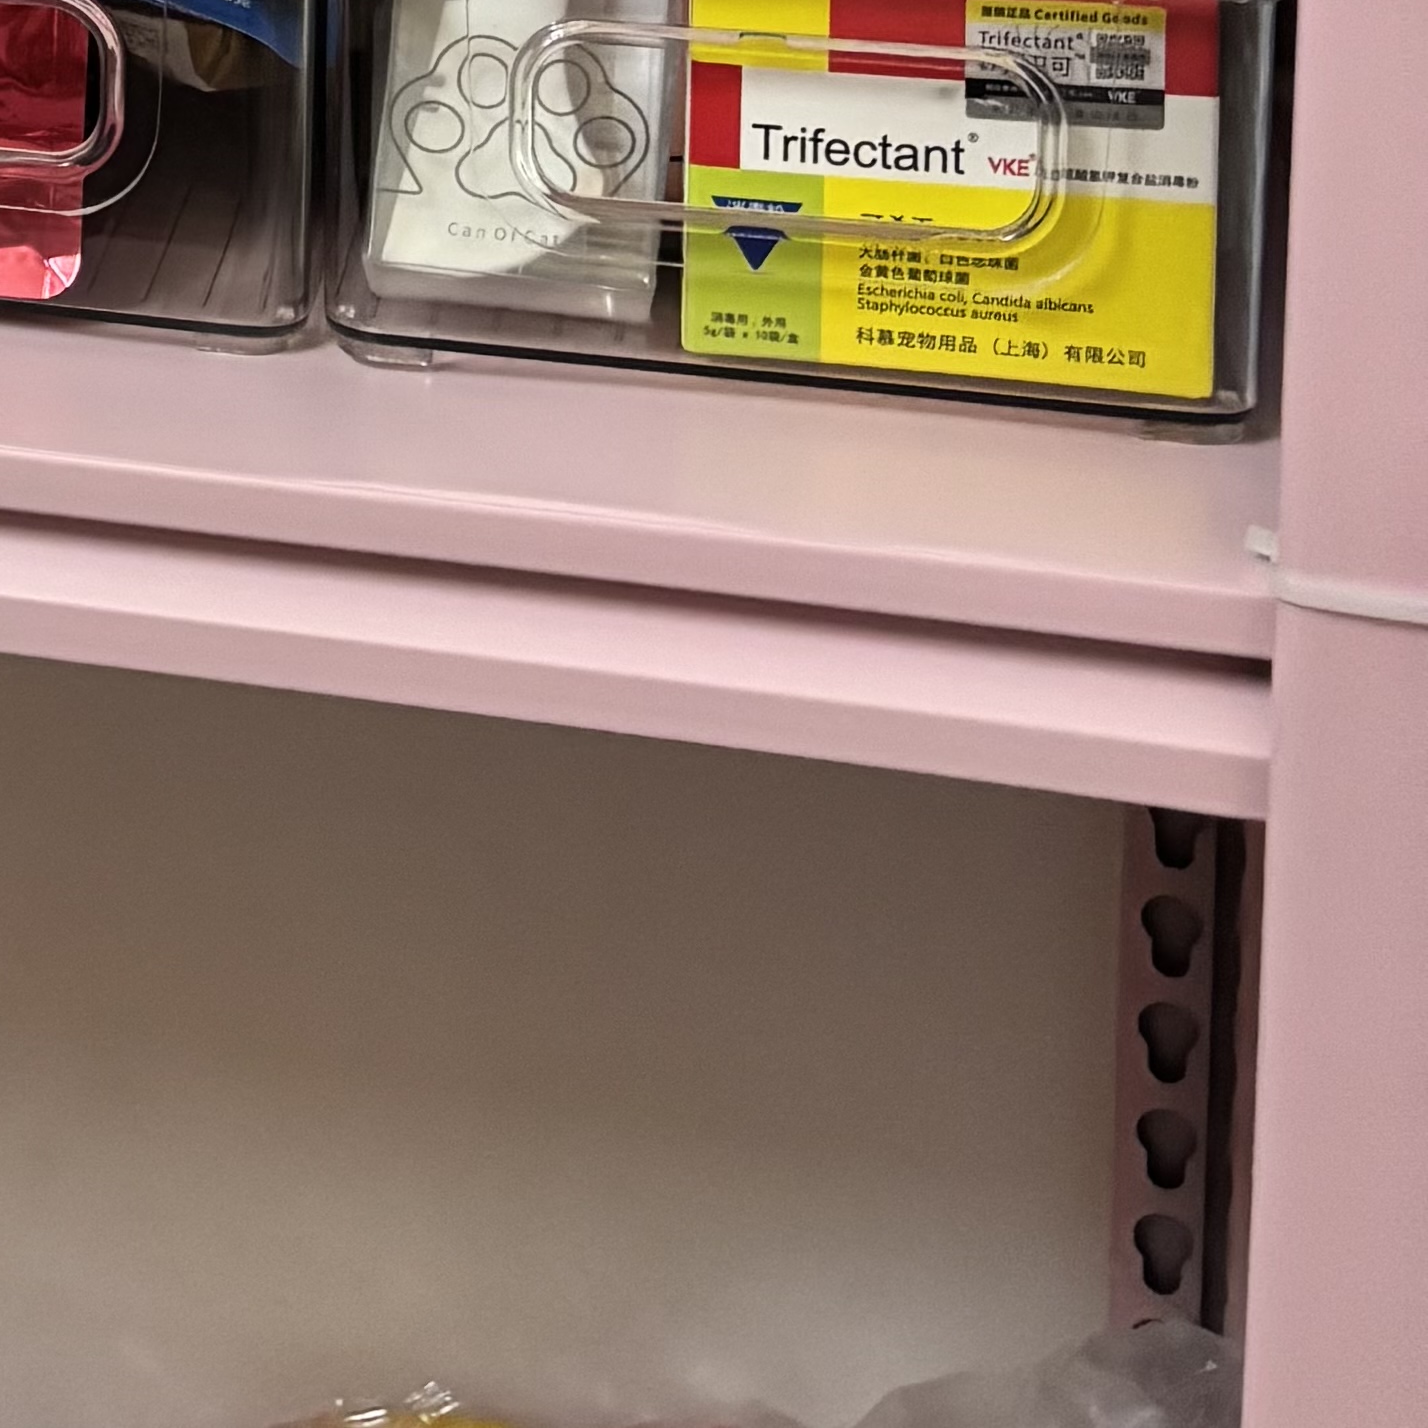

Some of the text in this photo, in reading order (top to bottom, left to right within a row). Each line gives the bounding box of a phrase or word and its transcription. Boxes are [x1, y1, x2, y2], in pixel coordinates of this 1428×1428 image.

[978, 30, 1075, 51] Trifectant
[751, 122, 1031, 178] Trifectant VKE
[447, 221, 486, 239] Can
[857, 283, 936, 302] Escherichia
[940, 290, 968, 306] coli,
[972, 293, 1032, 311] Candida
[857, 297, 967, 320] Staphylococcus
